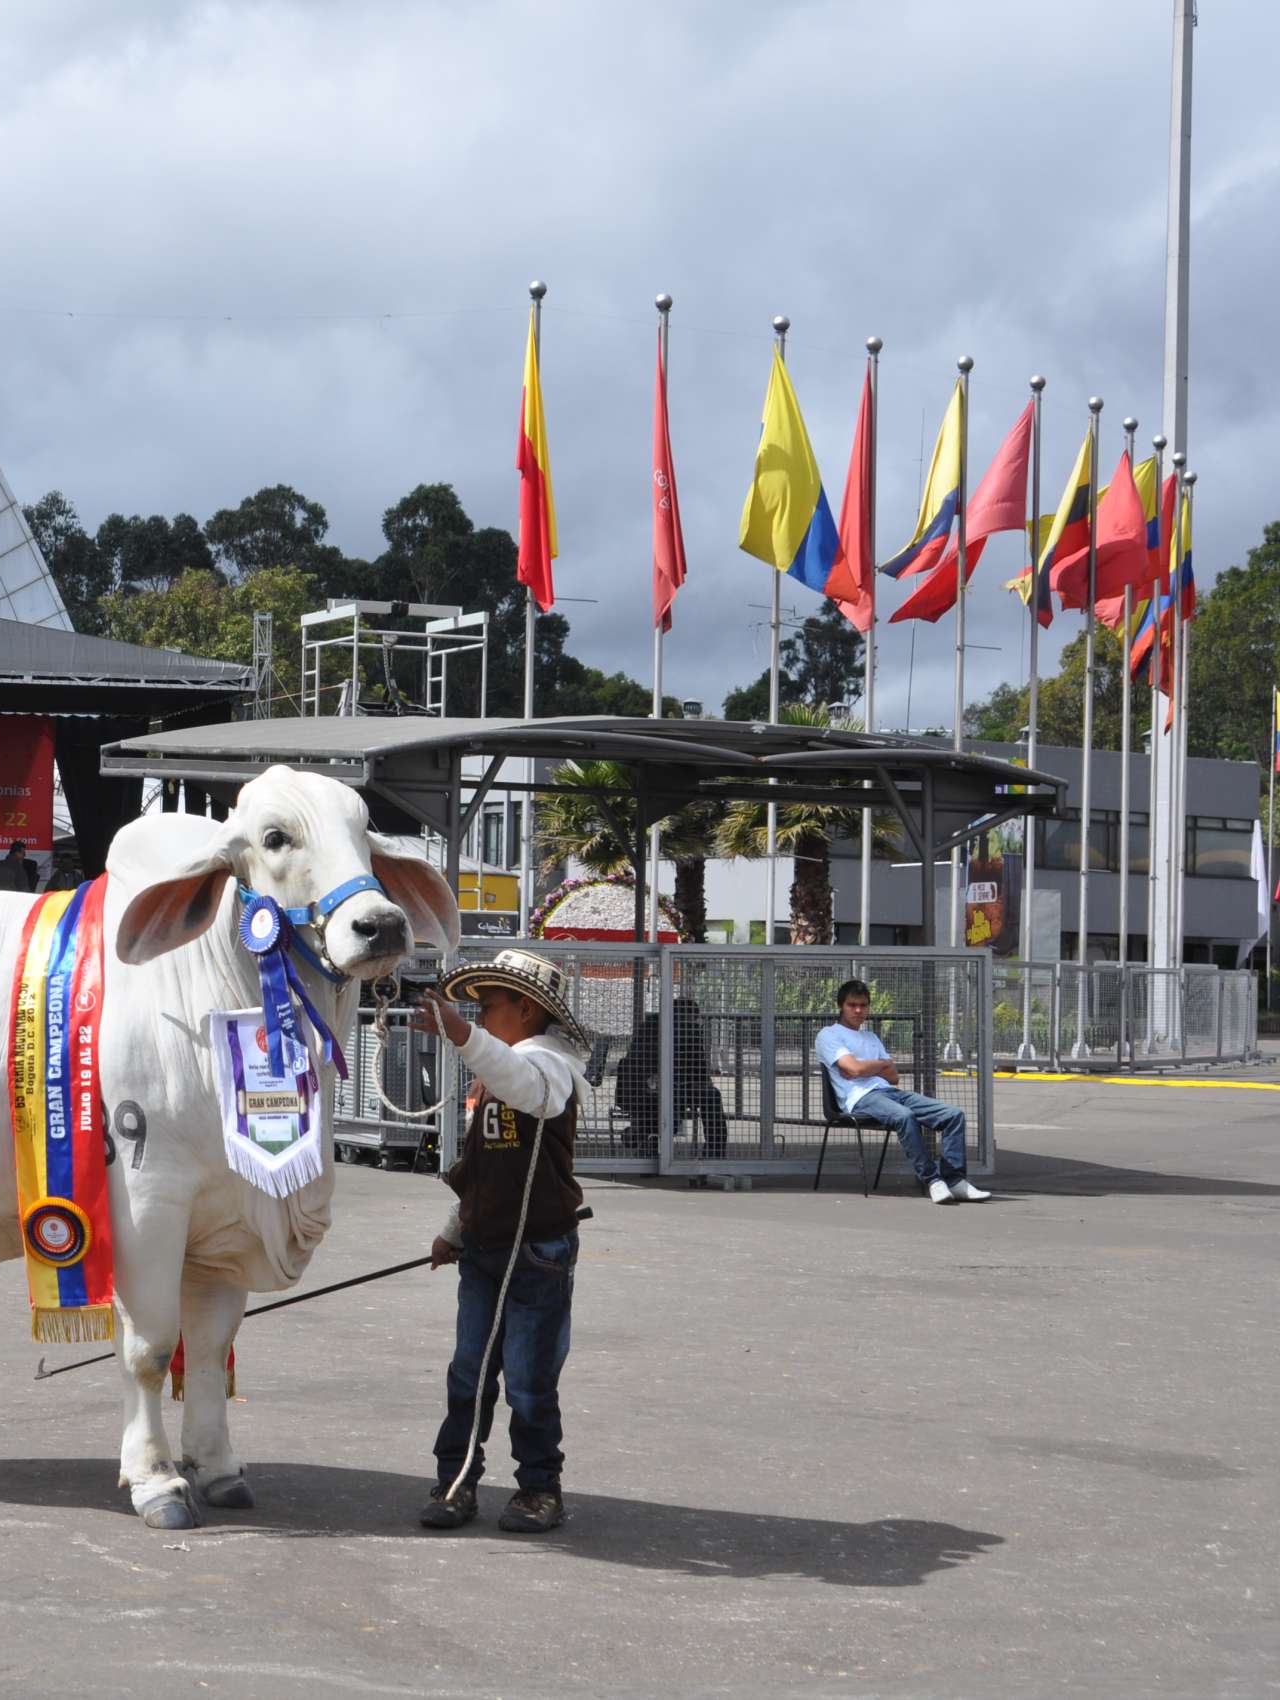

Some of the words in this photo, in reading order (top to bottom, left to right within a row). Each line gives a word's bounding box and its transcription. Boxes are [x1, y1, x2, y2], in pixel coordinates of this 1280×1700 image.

[5, 812, 27, 826] 22
[48, 972, 65, 1079] CAMPEONA
[79, 1025, 92, 1043] 22
[80, 1047, 91, 1065] AL
[80, 1072, 91, 1086] 19
[249, 1097, 264, 1108] GRAN
[48, 1085, 65, 1139] GRAN
[80, 1093, 91, 1131] JULIO
[483, 1102, 500, 1139] G
